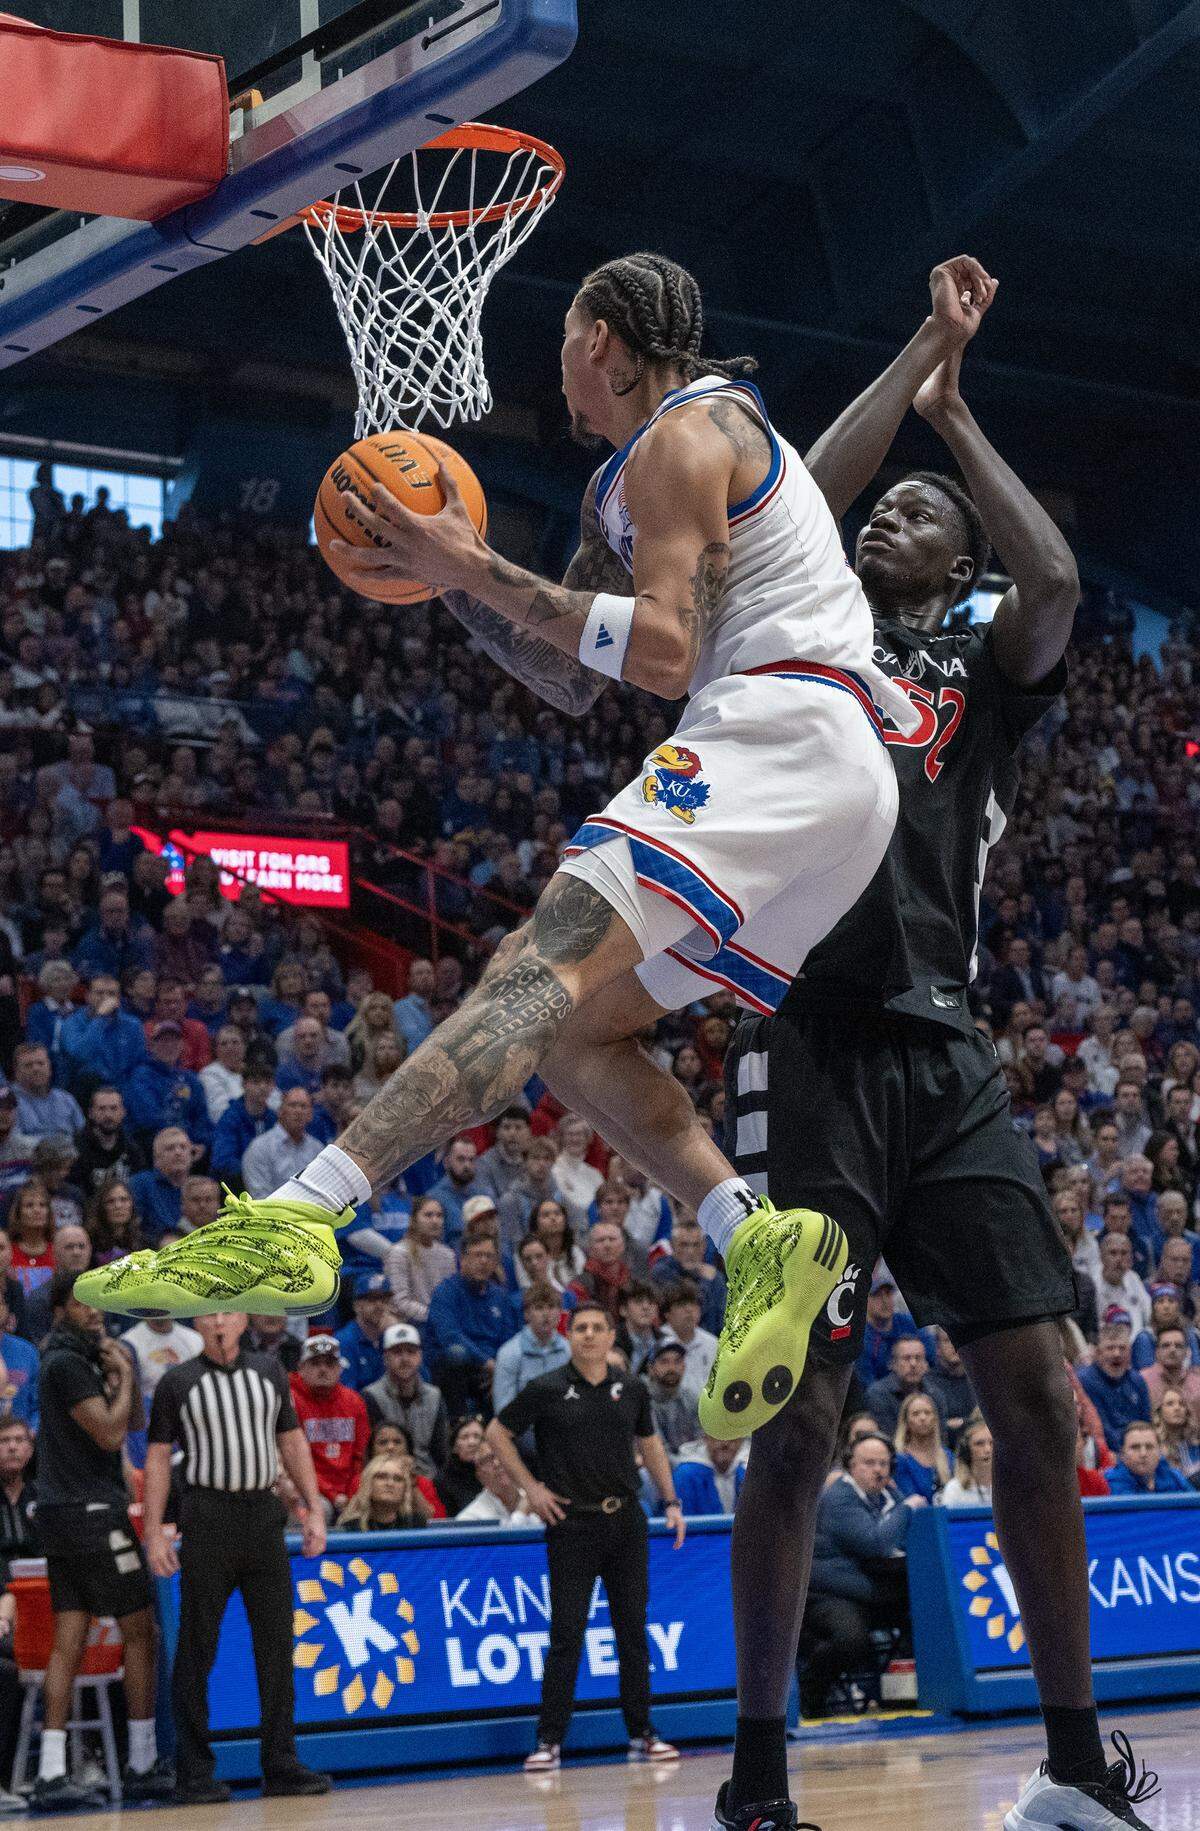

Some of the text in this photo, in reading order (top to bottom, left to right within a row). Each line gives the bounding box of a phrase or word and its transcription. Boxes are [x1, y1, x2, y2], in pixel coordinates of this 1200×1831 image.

[666, 781, 691, 798] KU
[210, 848, 256, 868] VISIT
[295, 872, 343, 893] MORE
[487, 983, 552, 1021] NEVER
[445, 1621, 685, 1688] LOTEY
